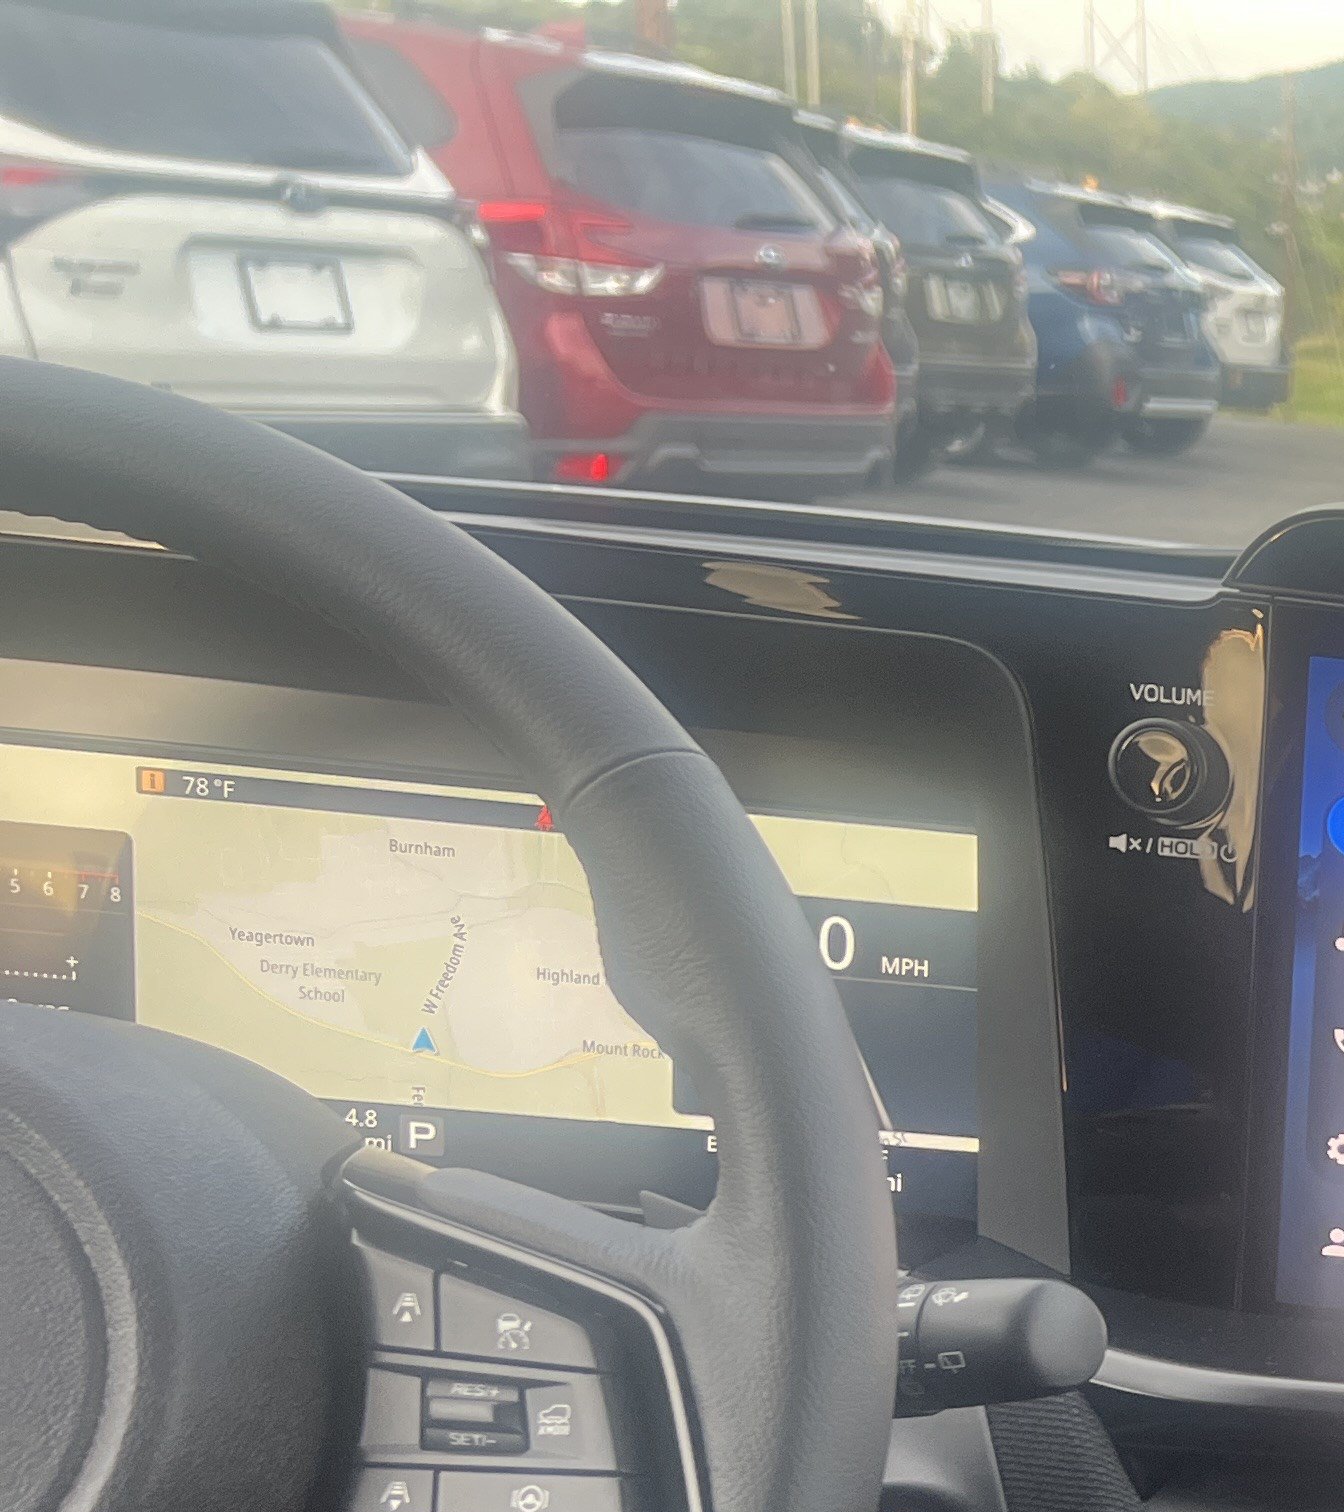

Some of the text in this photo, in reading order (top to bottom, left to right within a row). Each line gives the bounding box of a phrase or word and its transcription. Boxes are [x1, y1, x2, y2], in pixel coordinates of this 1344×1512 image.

[1130, 683, 1216, 707] VOLUME
[388, 837, 456, 858] Burnham
[10, 878, 122, 902] 5 6 7 8
[229, 927, 315, 947] Yeagertown
[818, 916, 856, 970] 0
[260, 959, 382, 986] Derry Elementary
[421, 914, 468, 1015] W Freedom Ave
[881, 955, 929, 978] MPH
[537, 966, 600, 987] Highland
[298, 985, 345, 1003] School
[582, 1039, 628, 1057] Mount
[344, 1107, 378, 1128] 4.8
[365, 1134, 392, 1152] mi
[409, 1121, 437, 1149] P
